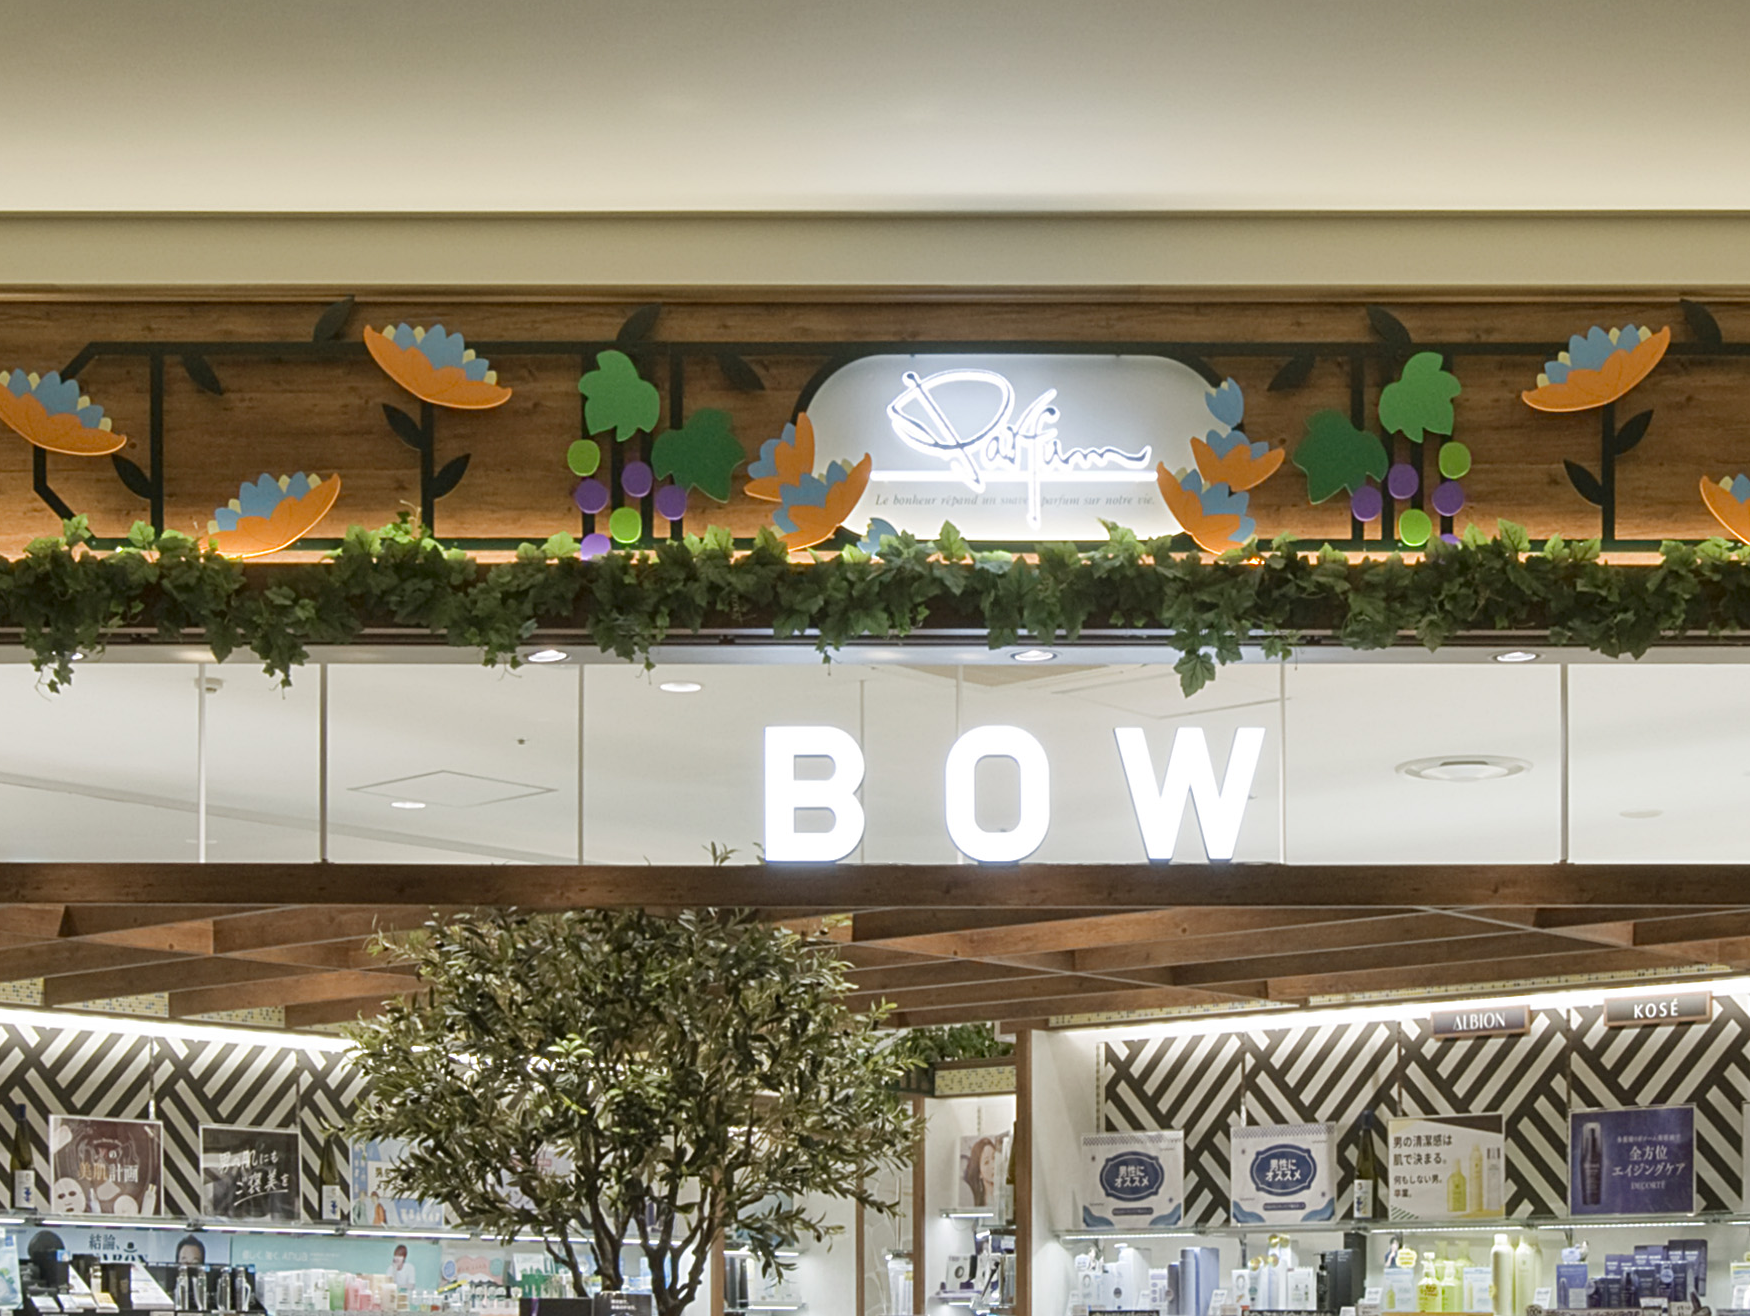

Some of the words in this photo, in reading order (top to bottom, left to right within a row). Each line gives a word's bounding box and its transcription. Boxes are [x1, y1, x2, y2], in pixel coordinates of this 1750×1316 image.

[875, 494, 889, 506] Le
[892, 494, 936, 506] bonheur
[940, 493, 978, 508] répand
[1083, 496, 1101, 506] sur
[1105, 494, 1134, 506] notre
[764, 725, 1266, 863] BOW
[1633, 998, 1679, 1020] KOSÉ
[1453, 1012, 1506, 1032] ALBION
[1393, 1134, 1453, 1149] 男の清潔感は
[1393, 1152, 1448, 1166] 肌で決まる。
[1629, 1145, 1668, 1161] 全方位
[78, 1160, 139, 1184] 美肌計画
[1118, 1165, 1145, 1177] 男性に
[1269, 1158, 1296, 1171] 男性に
[1612, 1162, 1686, 1178] エイジングケア
[1114, 1176, 1150, 1188] オススメ
[1265, 1170, 1302, 1182] オススメ
[1393, 1174, 1443, 1185] 何もしない男。
[88, 1233, 121, 1251] 結論、
